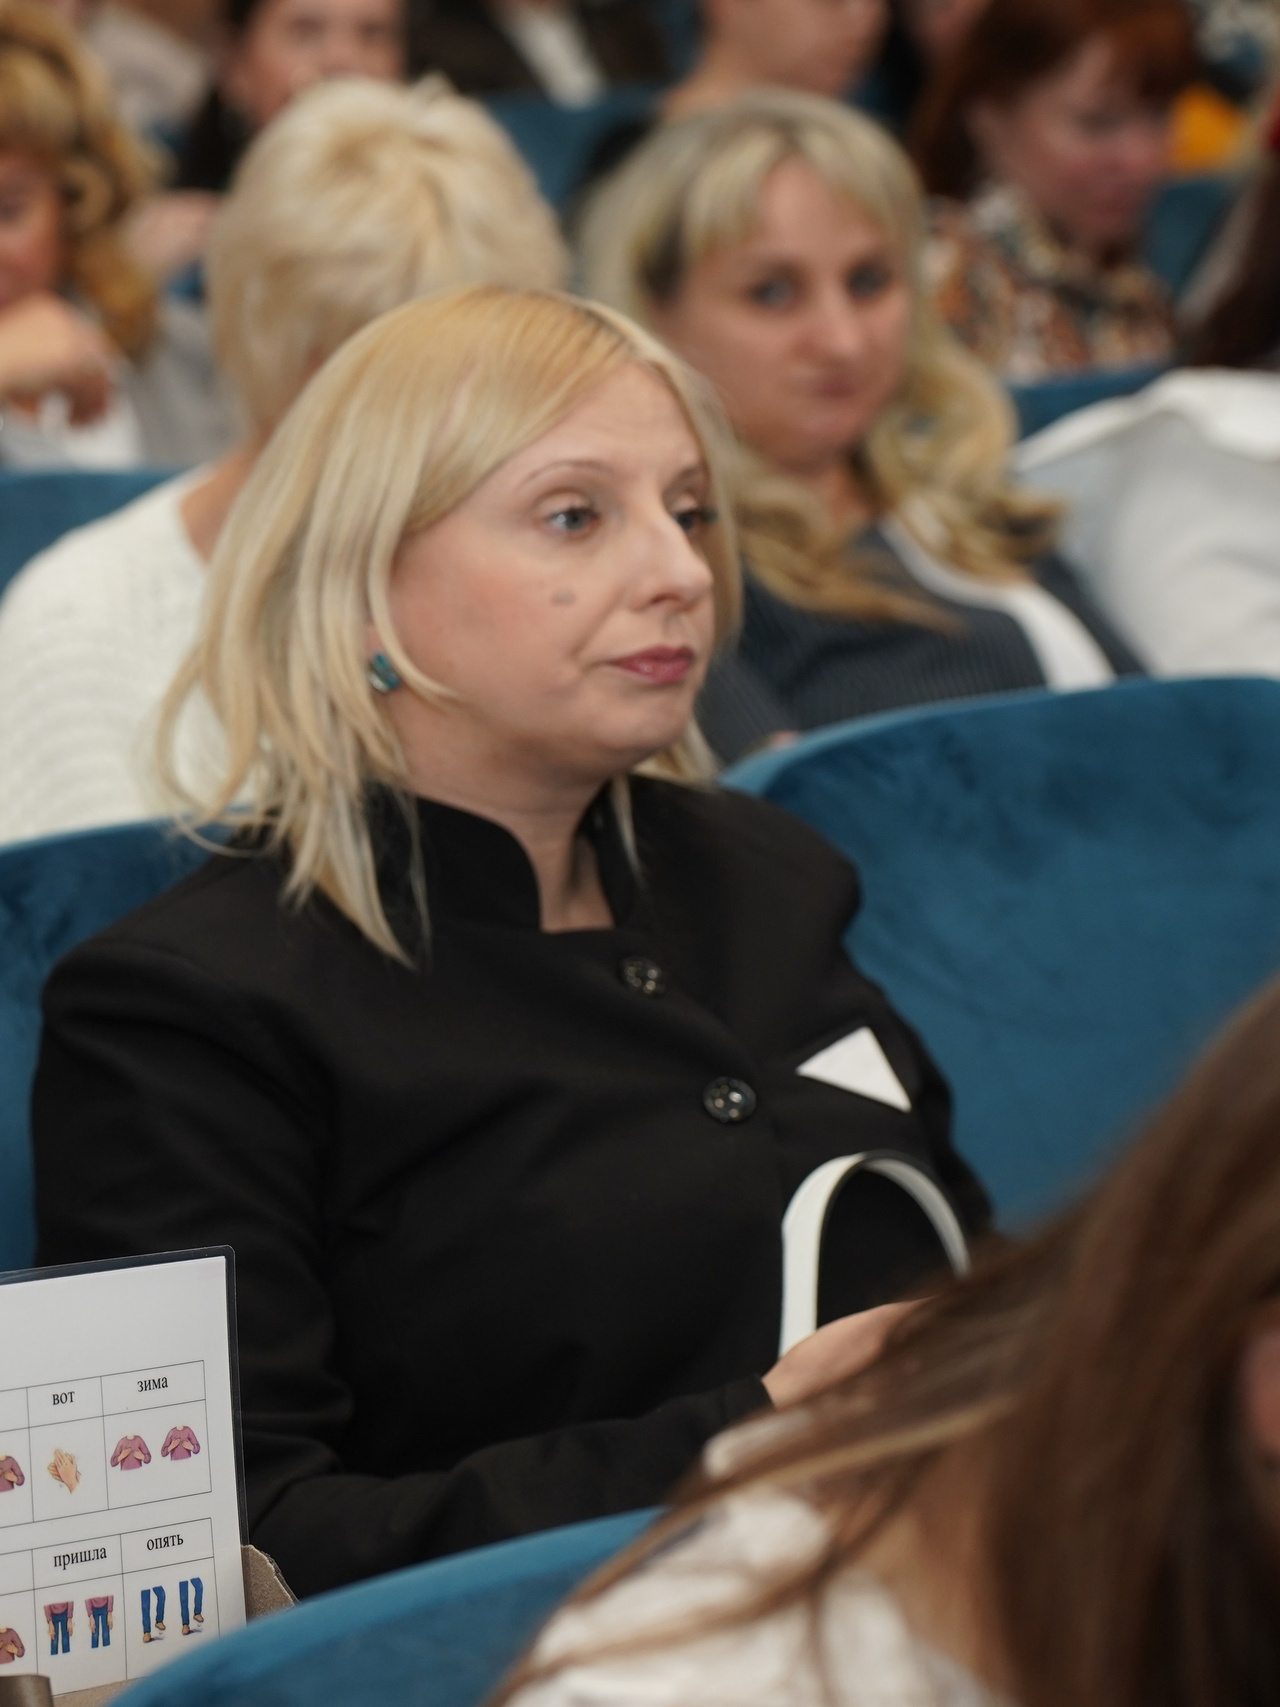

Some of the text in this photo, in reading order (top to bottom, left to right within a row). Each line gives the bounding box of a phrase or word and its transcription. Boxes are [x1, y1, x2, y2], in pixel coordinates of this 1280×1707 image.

[52, 1391, 75, 1406] вот
[137, 1376, 168, 1393] зима
[53, 1547, 107, 1570] пришла
[146, 1534, 184, 1551] опять
